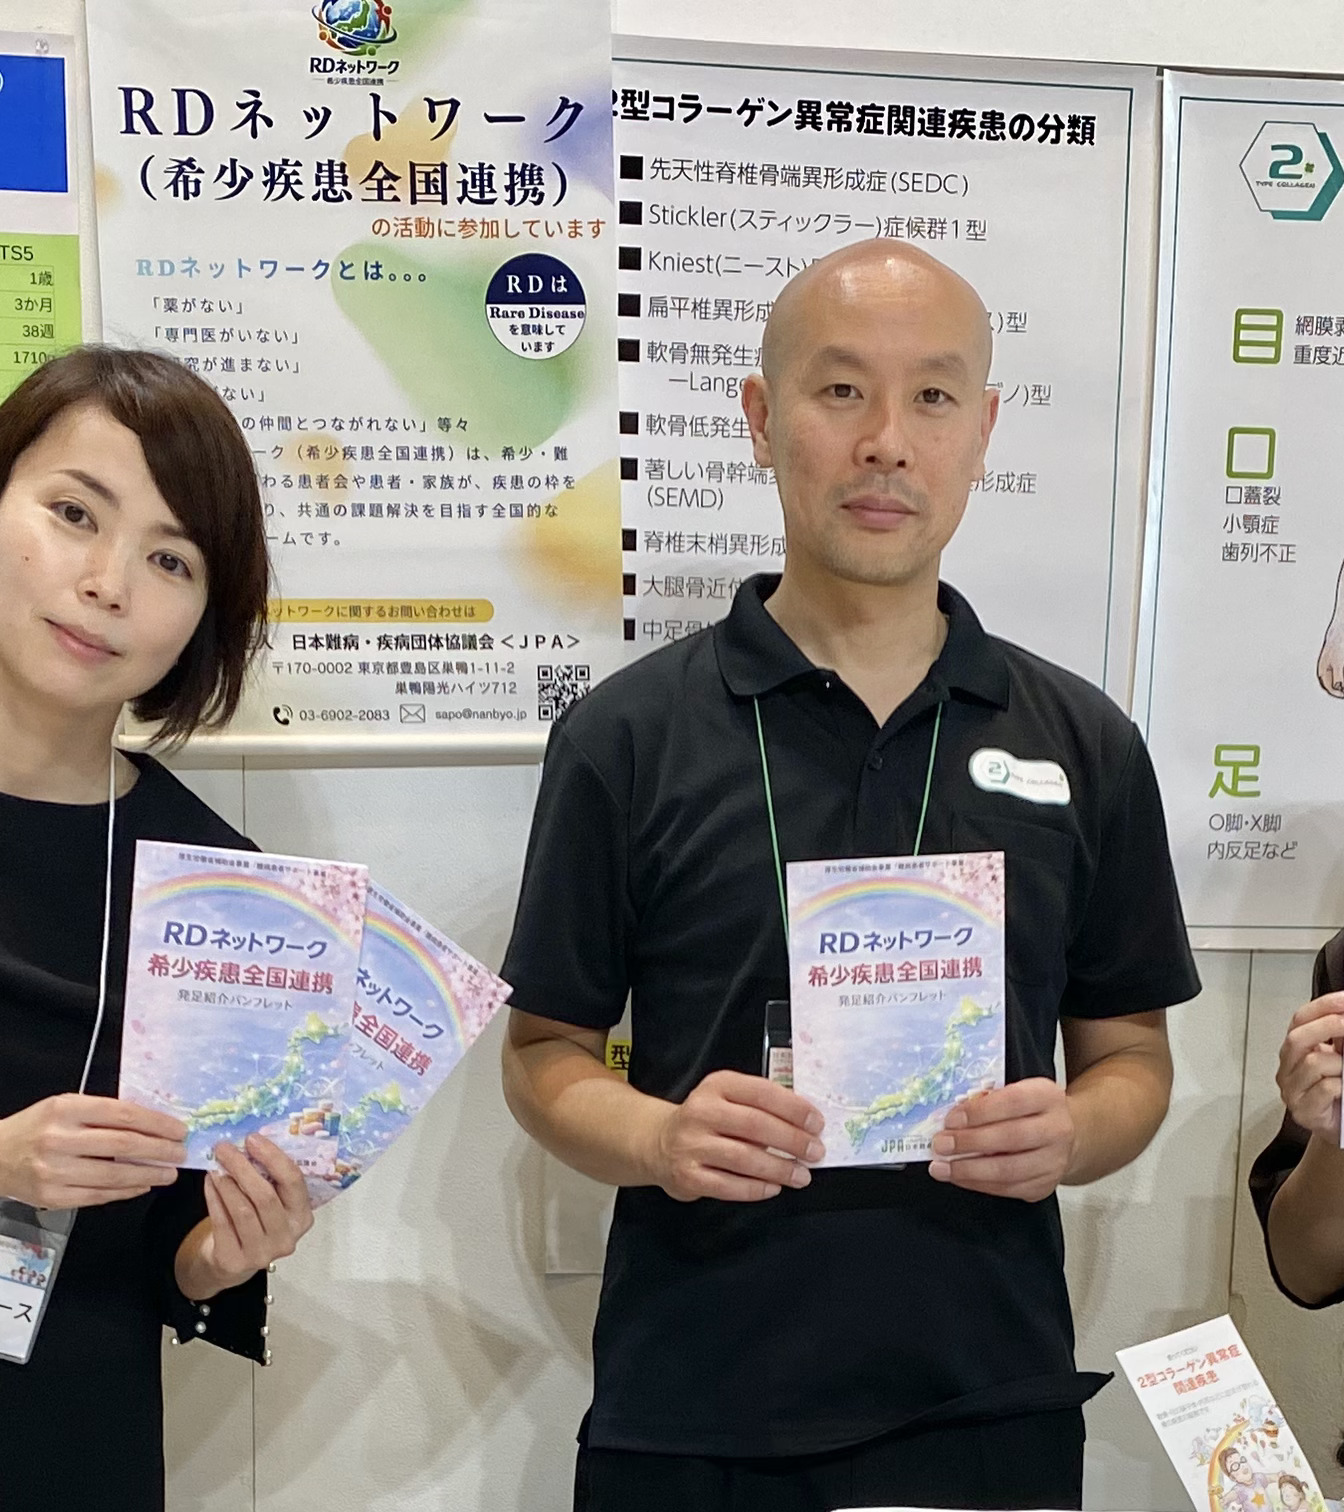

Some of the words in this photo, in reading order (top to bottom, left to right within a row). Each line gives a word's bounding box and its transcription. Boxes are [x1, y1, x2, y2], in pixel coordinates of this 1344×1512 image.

[310, 57, 400, 75] RDネットワーク
[117, 86, 586, 145] RDネットワーク
[139, 154, 570, 208] （希少疾患全国連携）
[371, 217, 607, 240] の活動に参加しています
[152, 297, 244, 315] 「薬がない」
[489, 306, 526, 321] Rare
[529, 307, 585, 321] Disease
[153, 327, 300, 345] 「専門医がいない」
[509, 322, 566, 337] を意味して
[1233, 308, 1284, 364] 目
[520, 340, 555, 354] います
[1225, 427, 1276, 480] 口
[646, 488, 725, 511] (SEMD)
[1224, 485, 1282, 507] 口蓋裂
[1222, 513, 1280, 536] 小顎症
[1221, 542, 1297, 565] 歯列不正
[299, 708, 390, 722] 03-6902-2083
[435, 708, 527, 724] sapo@nanbyo.jp
[1208, 744, 1262, 800] 足
[1207, 839, 1298, 862] 内反足など
[163, 921, 328, 960] RDネットワーク
[819, 926, 973, 954] RDネットワーク
[147, 953, 334, 995] 希少疾患全国連携
[808, 957, 983, 987] 希少疾患全国連携
